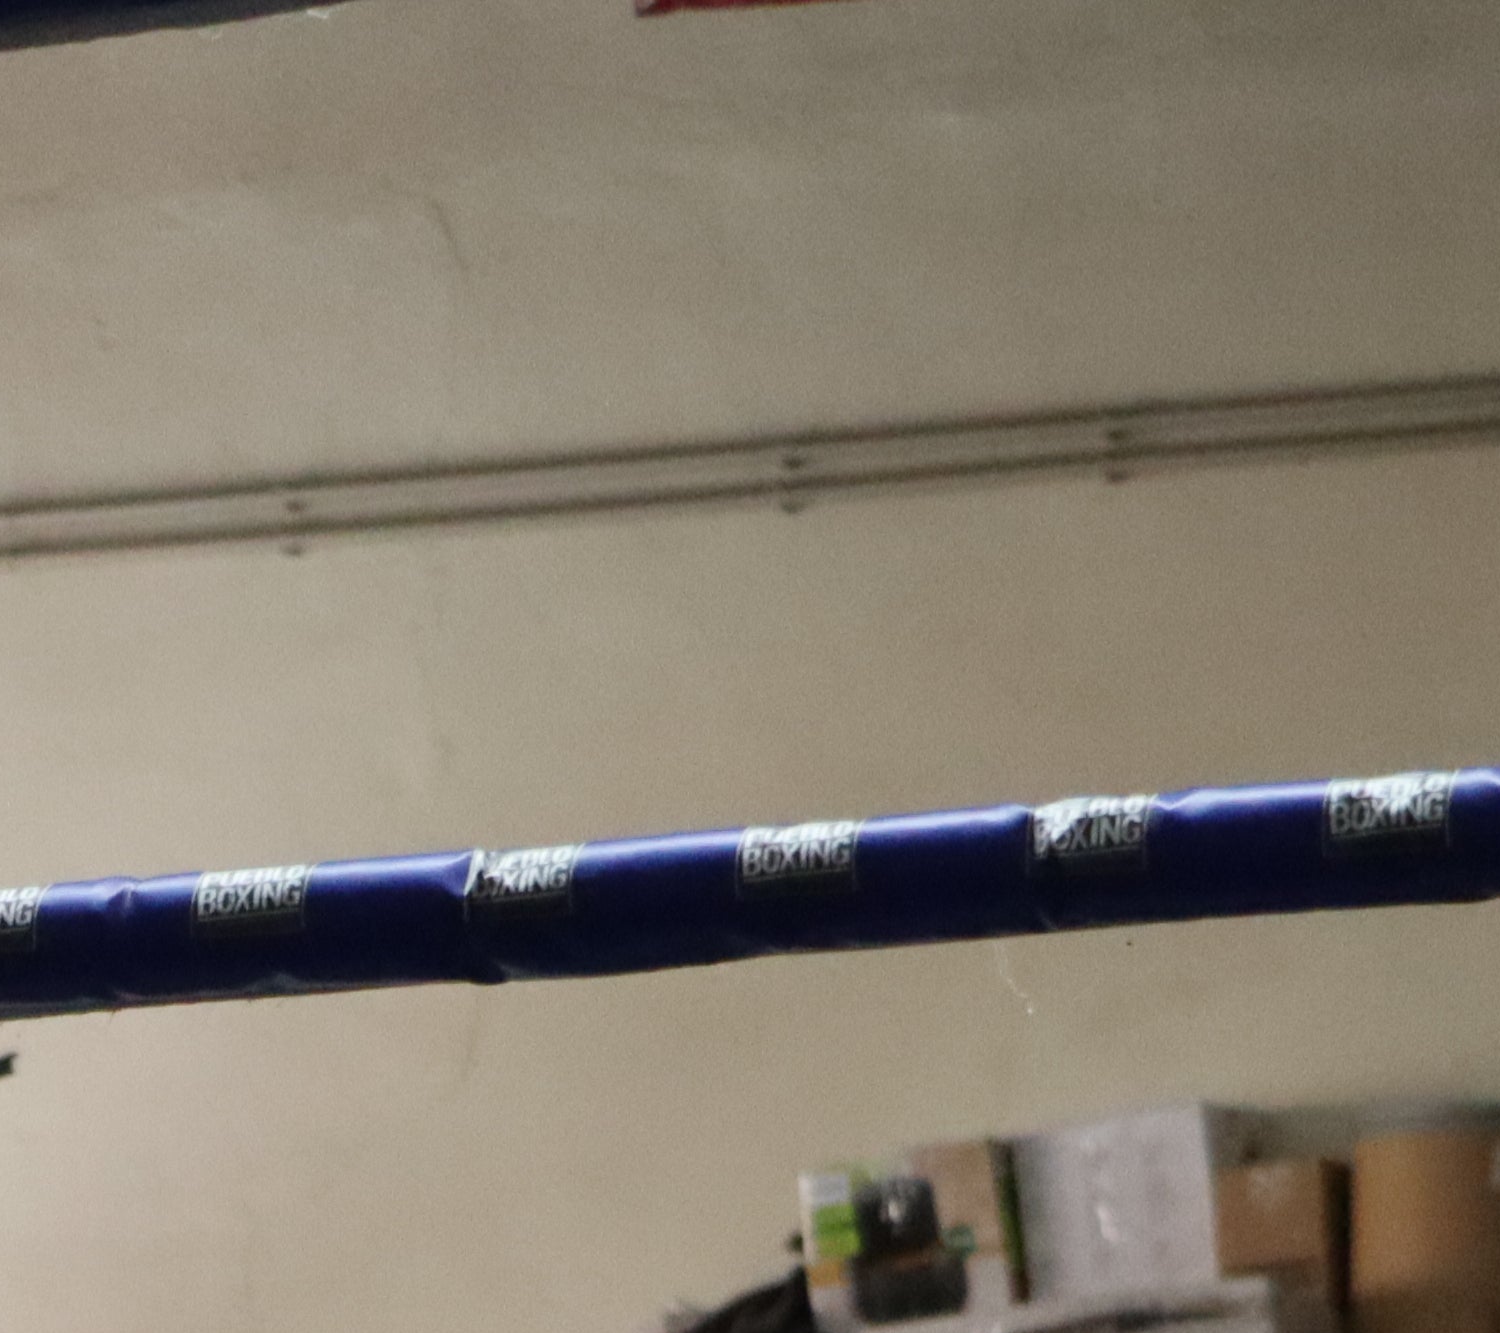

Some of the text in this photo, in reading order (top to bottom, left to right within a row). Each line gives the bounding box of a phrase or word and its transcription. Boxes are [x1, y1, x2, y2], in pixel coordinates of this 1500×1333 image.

[1331, 796, 1443, 831] BOXING
[745, 843, 849, 873] BOXING
[201, 885, 301, 914] BOXING
